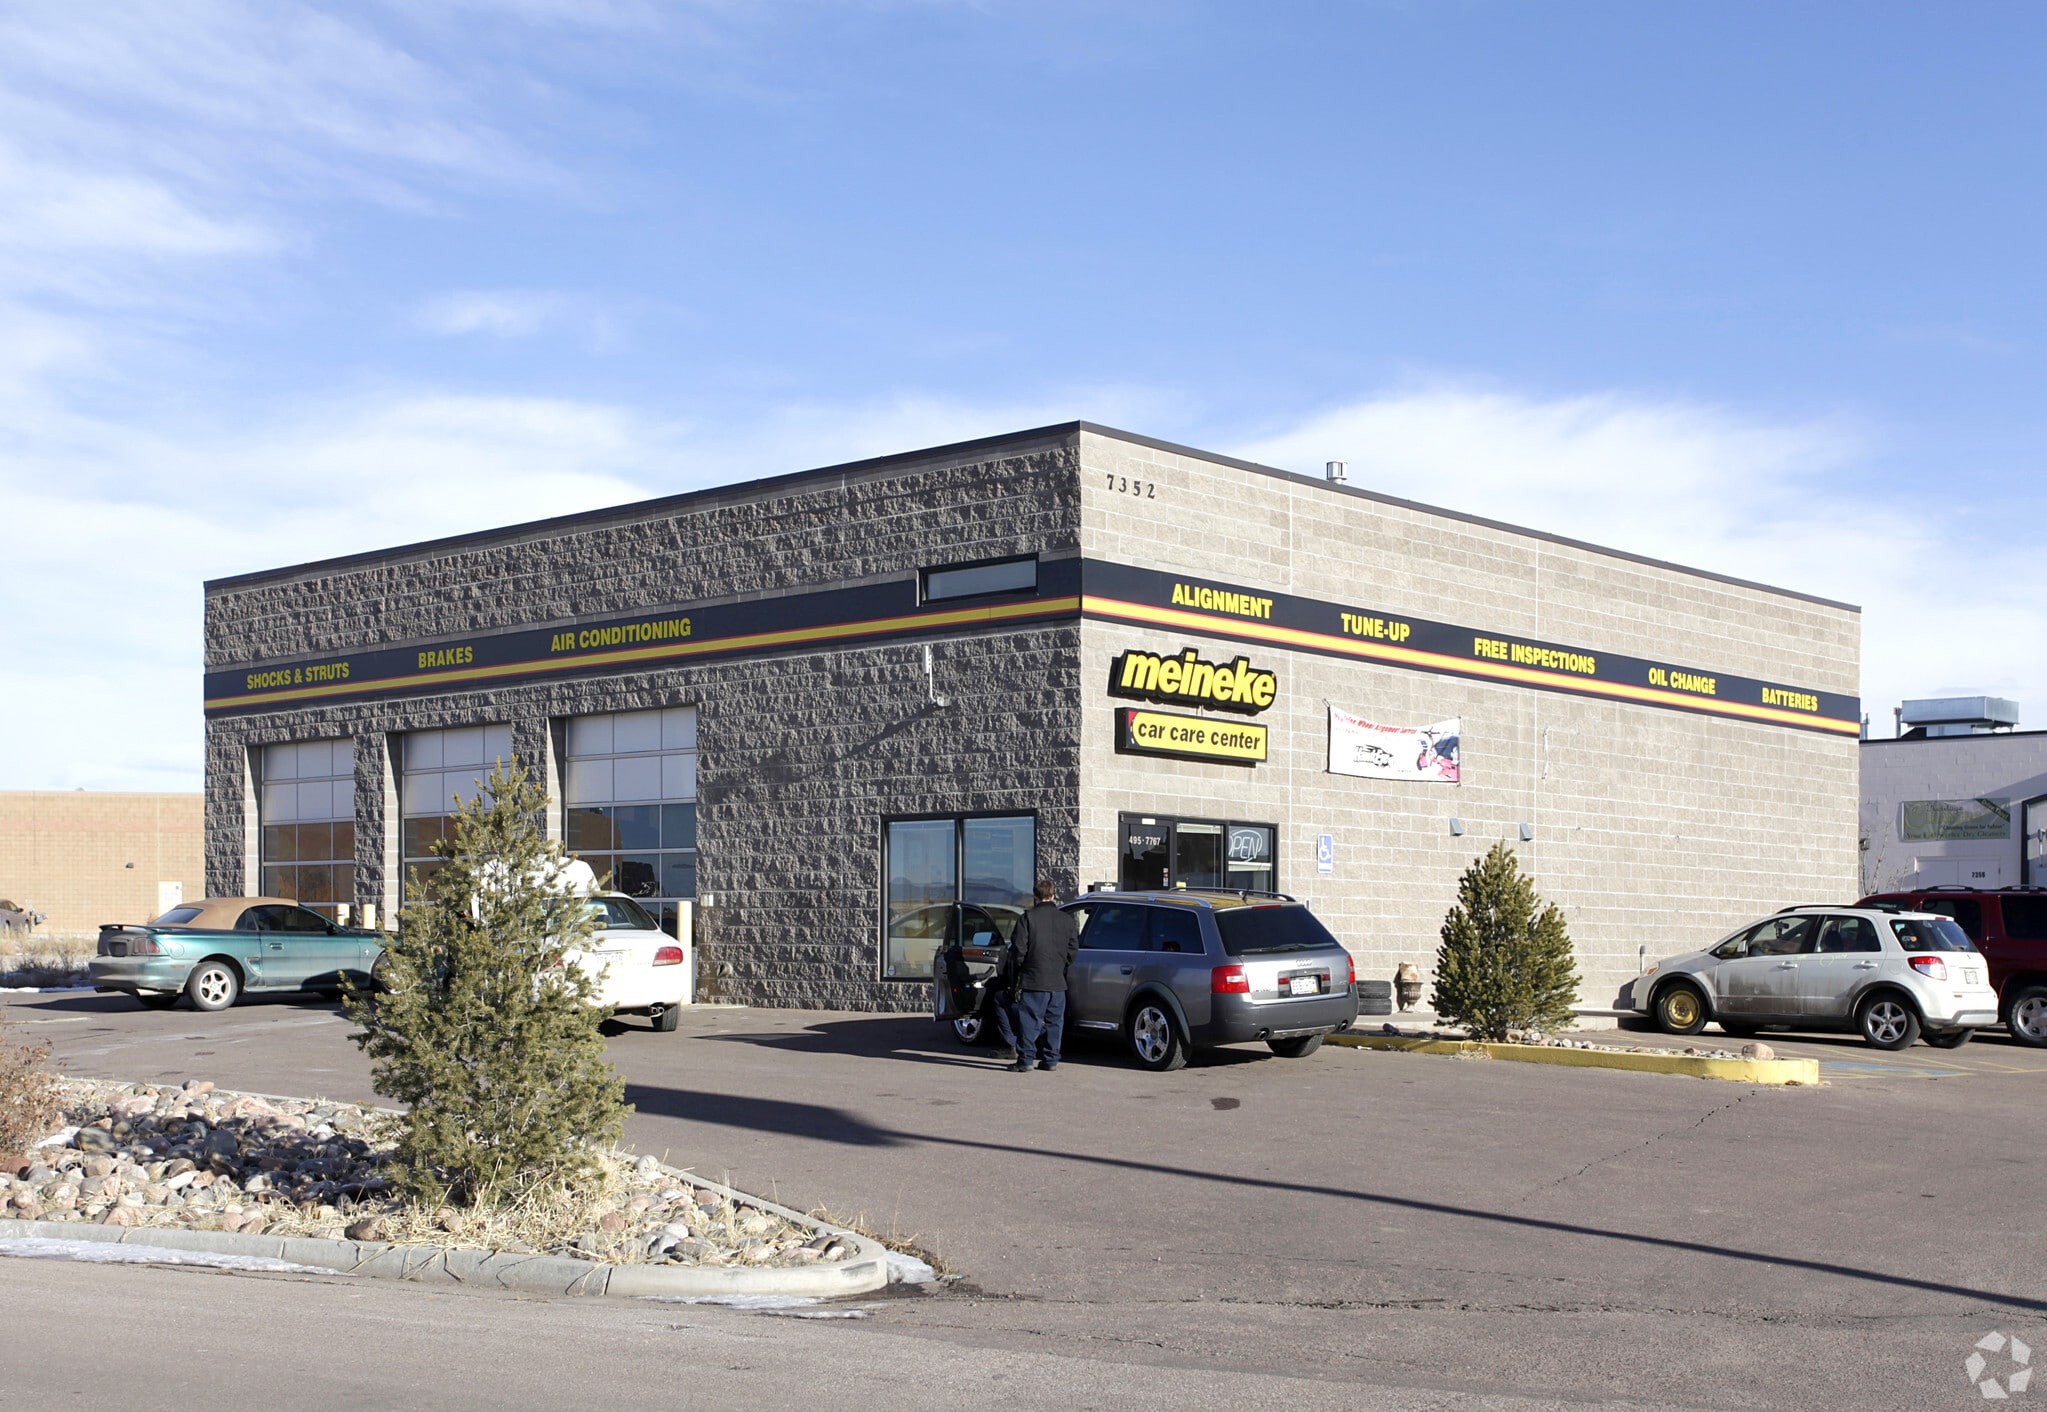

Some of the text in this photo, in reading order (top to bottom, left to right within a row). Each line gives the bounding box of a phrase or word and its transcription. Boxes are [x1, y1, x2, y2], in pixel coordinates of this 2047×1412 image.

[1107, 473, 1156, 500] 7352
[1171, 583, 1274, 619] ALIGNMENT
[551, 618, 691, 652] AIR CONDITIONING
[1340, 613, 1411, 642] TUNE-UP
[418, 646, 473, 669] BRAKES
[1473, 637, 1596, 675] FREE INSPECTIONS
[247, 662, 350, 690] SHOCKS & STRUTS
[1120, 651, 1276, 707] meineke
[1647, 667, 1716, 695] OIL CHANGE
[1761, 687, 1819, 712] BATTERIES
[1138, 722, 1261, 751] car care center
